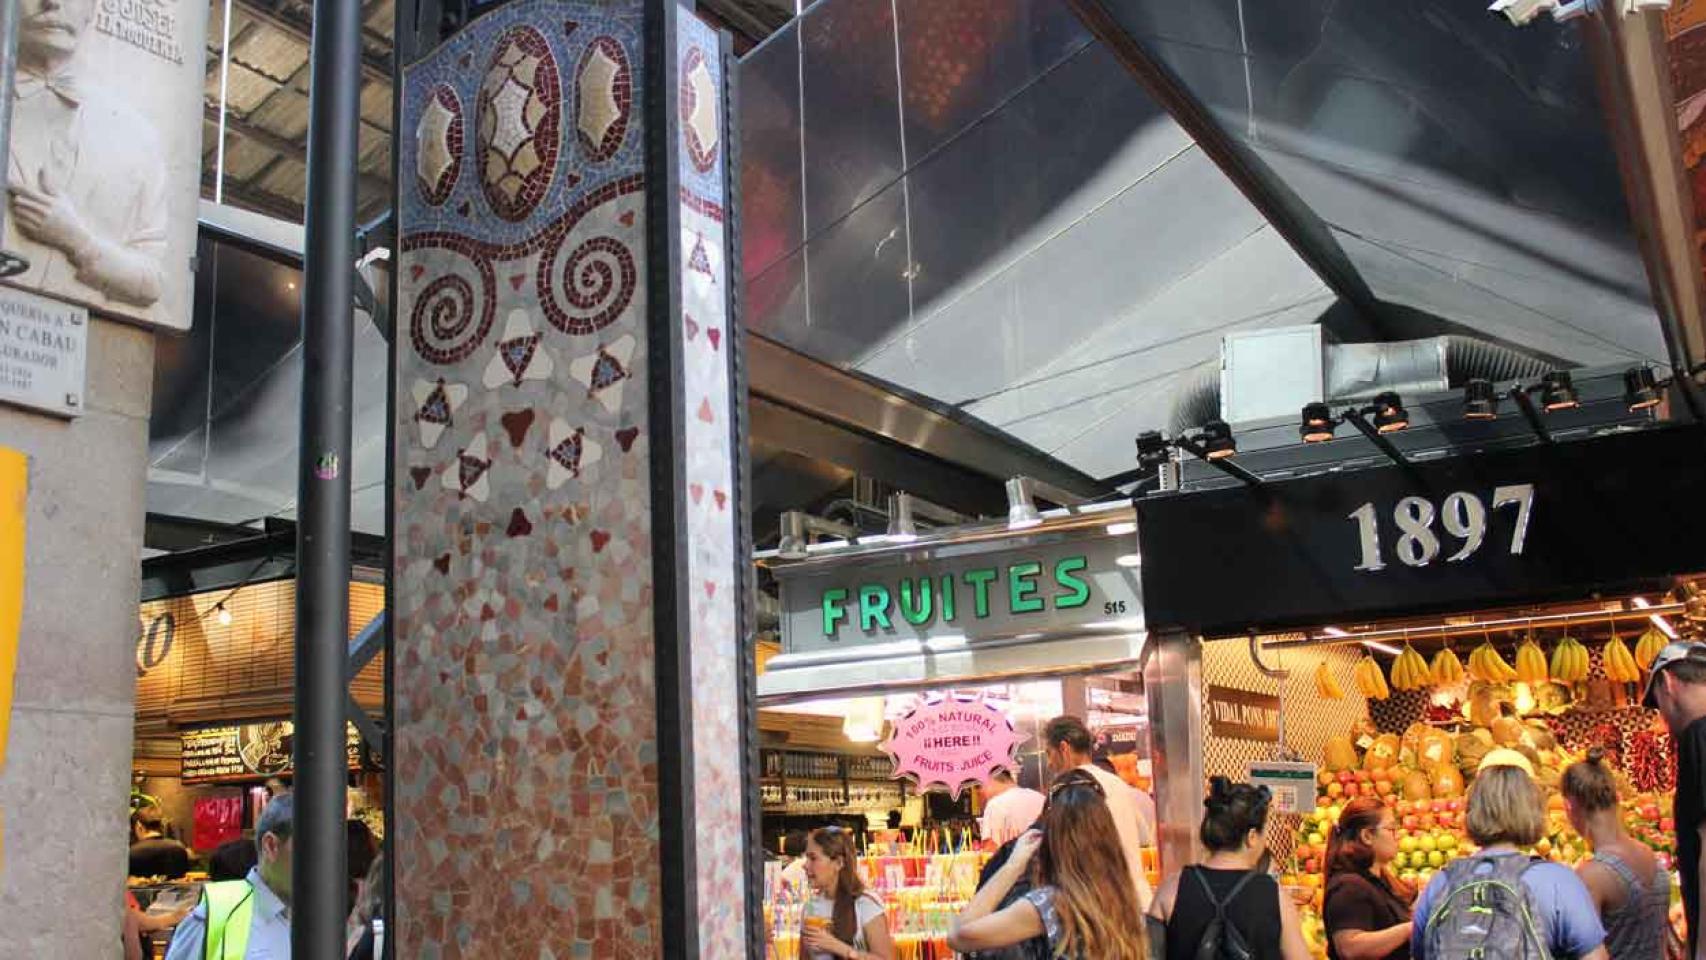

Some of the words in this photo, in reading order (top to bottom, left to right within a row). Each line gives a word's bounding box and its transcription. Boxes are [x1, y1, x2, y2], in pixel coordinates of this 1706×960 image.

[16, 326, 77, 353] CABAU
[1347, 483, 1535, 572] 1897
[822, 555, 1091, 636] FRUITES
[1103, 600, 1127, 615] 515
[938, 711, 998, 735] NATURAL
[913, 754, 955, 773] FRUITS
[960, 750, 993, 771] JUICE
